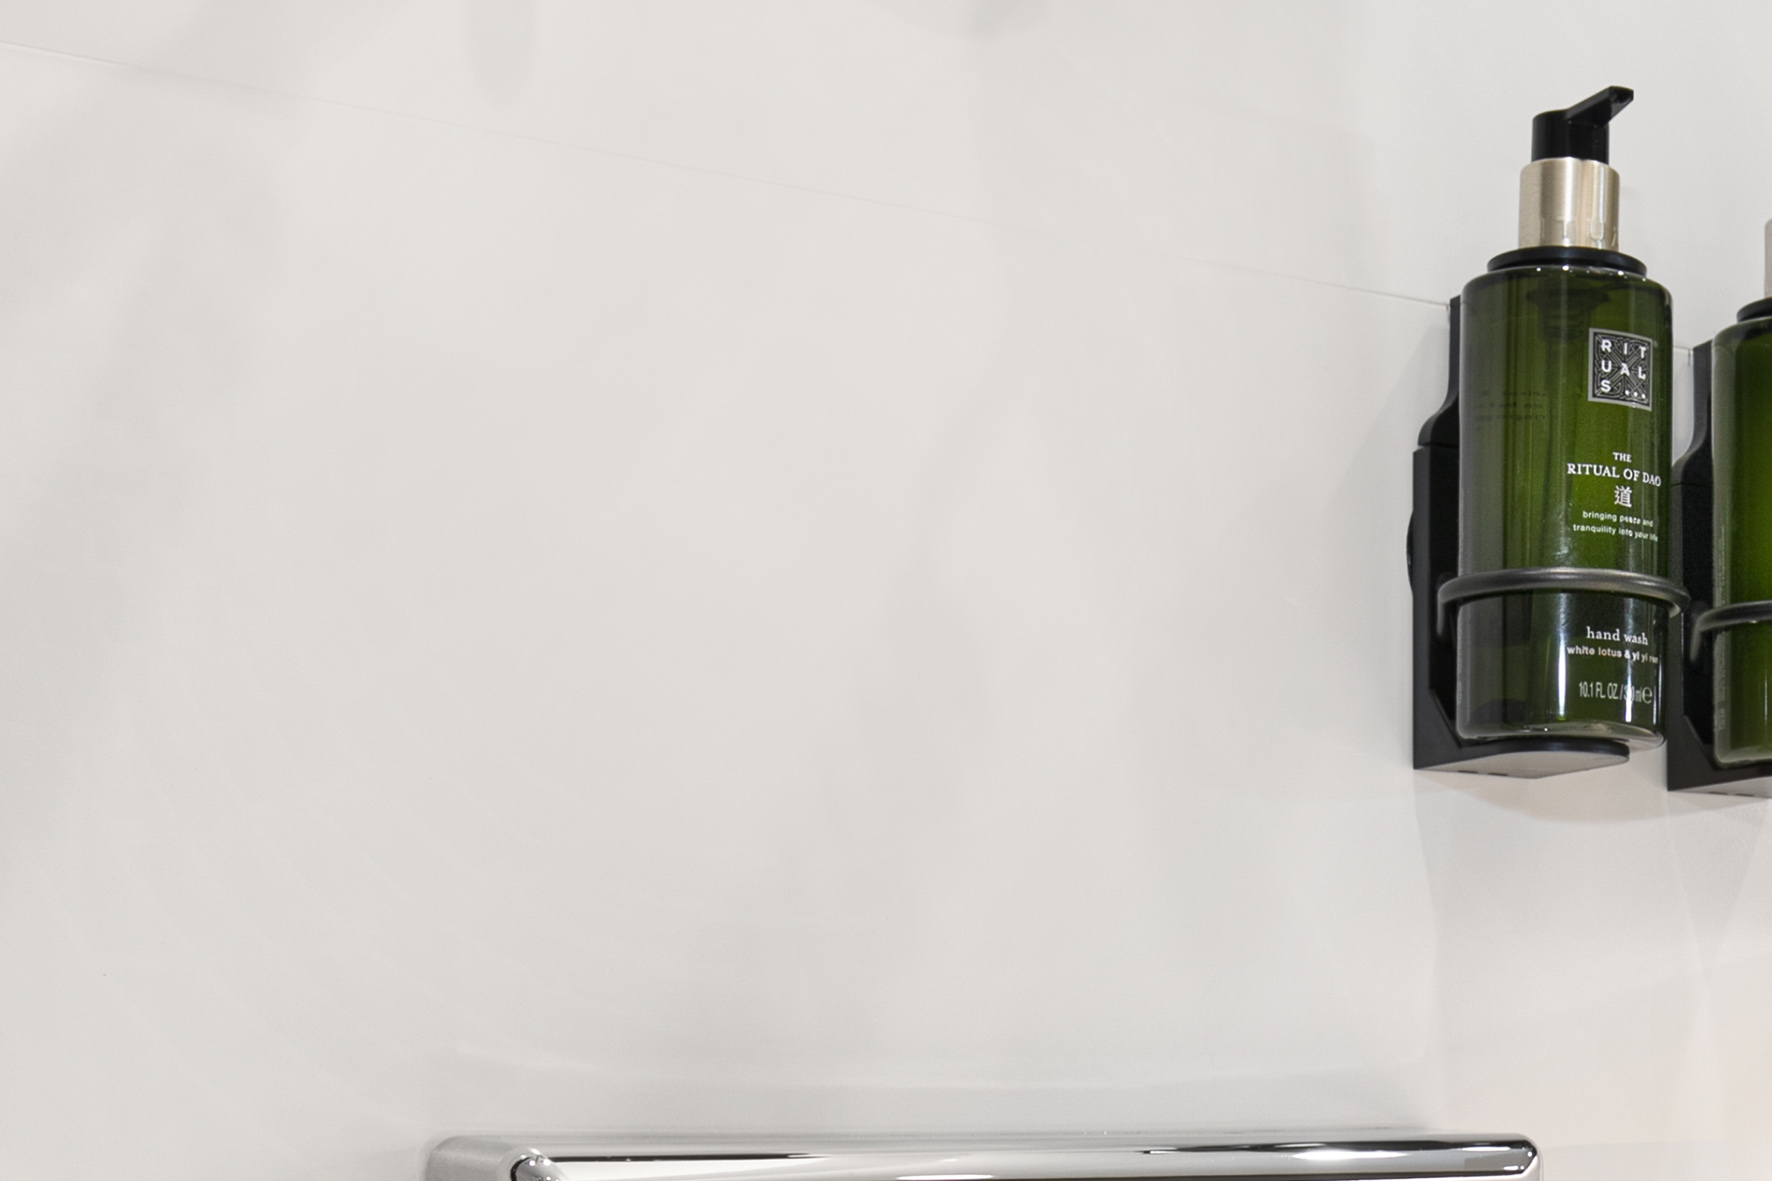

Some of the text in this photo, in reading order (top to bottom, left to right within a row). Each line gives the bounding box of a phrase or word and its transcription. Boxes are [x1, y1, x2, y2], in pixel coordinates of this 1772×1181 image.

[1613, 452, 1632, 463] THE
[1567, 463, 1661, 487] RITUAL OF DAO
[1614, 485, 1632, 508] 道
[1582, 510, 1617, 523] bringing
[1619, 514, 1641, 525] peace
[1573, 524, 1616, 536] tranquility
[1618, 527, 1633, 537] into
[1634, 531, 1649, 539] your
[1586, 626, 1649, 646] hand wash
[1567, 645, 1595, 655] white
[1598, 646, 1622, 658] lotus
[1624, 649, 1632, 659] &
[1631, 651, 1640, 662] yi
[1641, 653, 1649, 663] yi
